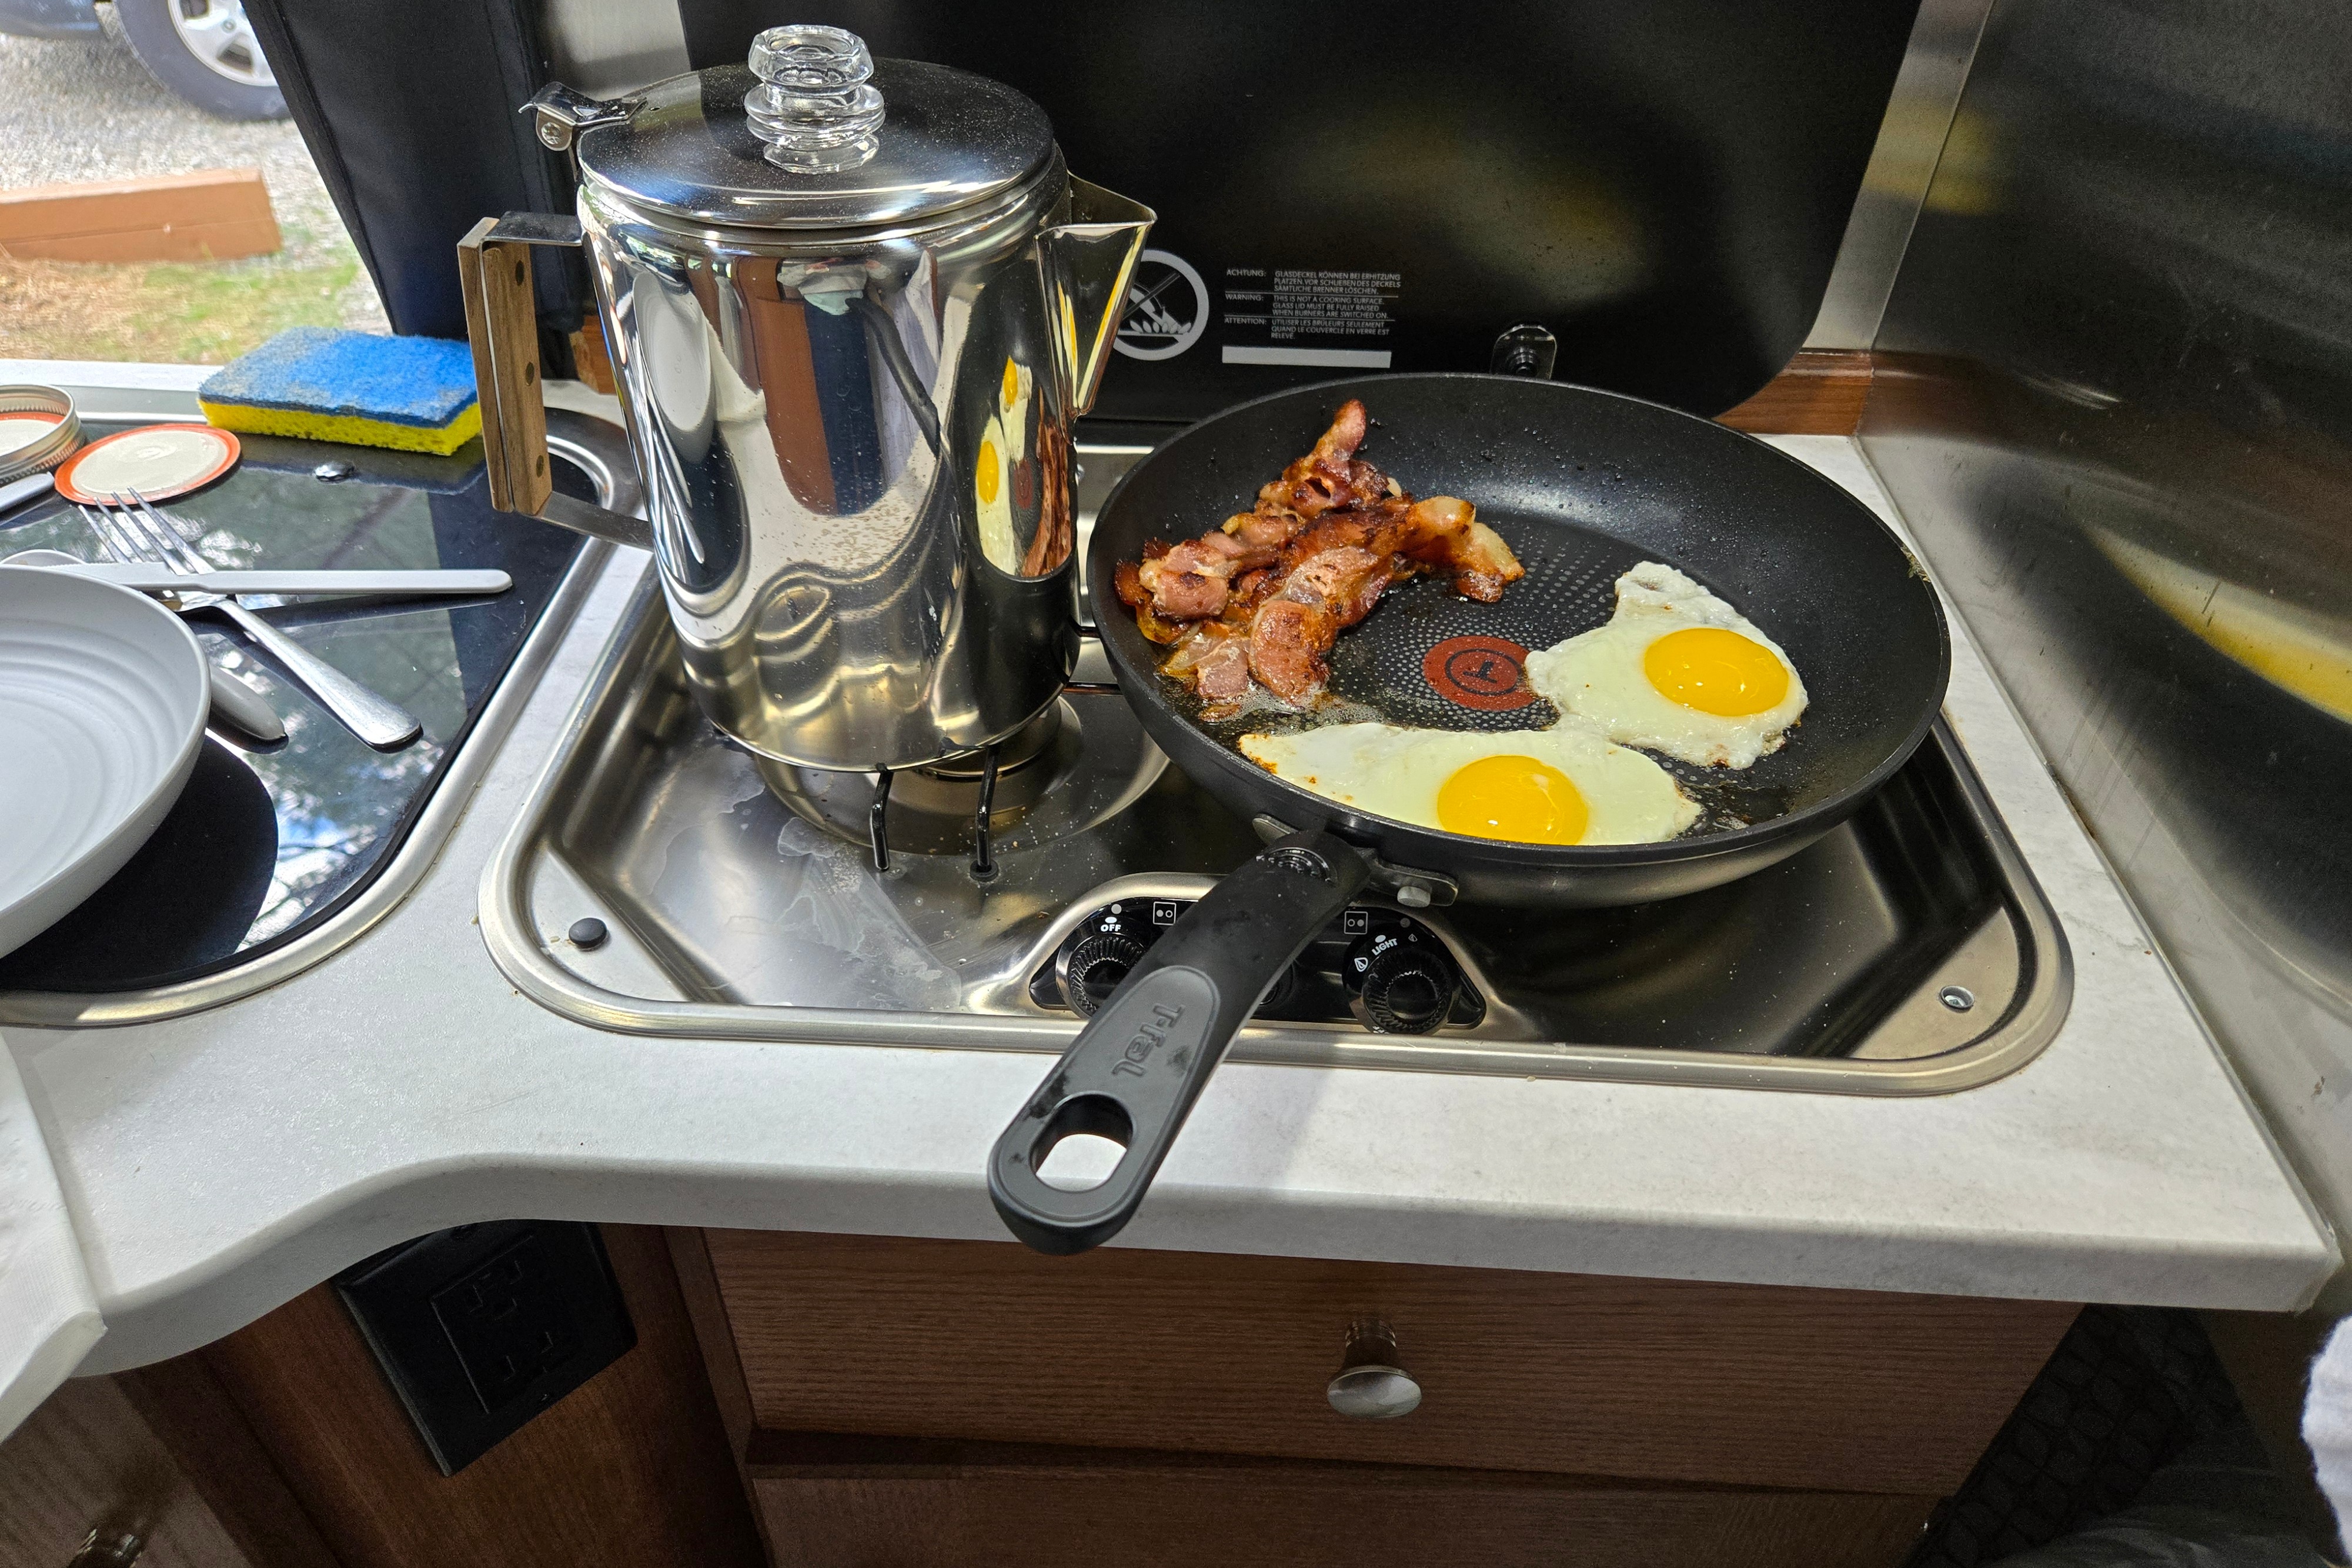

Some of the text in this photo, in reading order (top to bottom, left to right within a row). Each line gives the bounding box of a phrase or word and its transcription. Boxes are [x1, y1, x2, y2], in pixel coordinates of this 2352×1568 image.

[1226, 269, 1266, 277] ACHTUNG:
[1100, 924, 1122, 932] OFF
[1371, 938, 1398, 956] LIGHT
